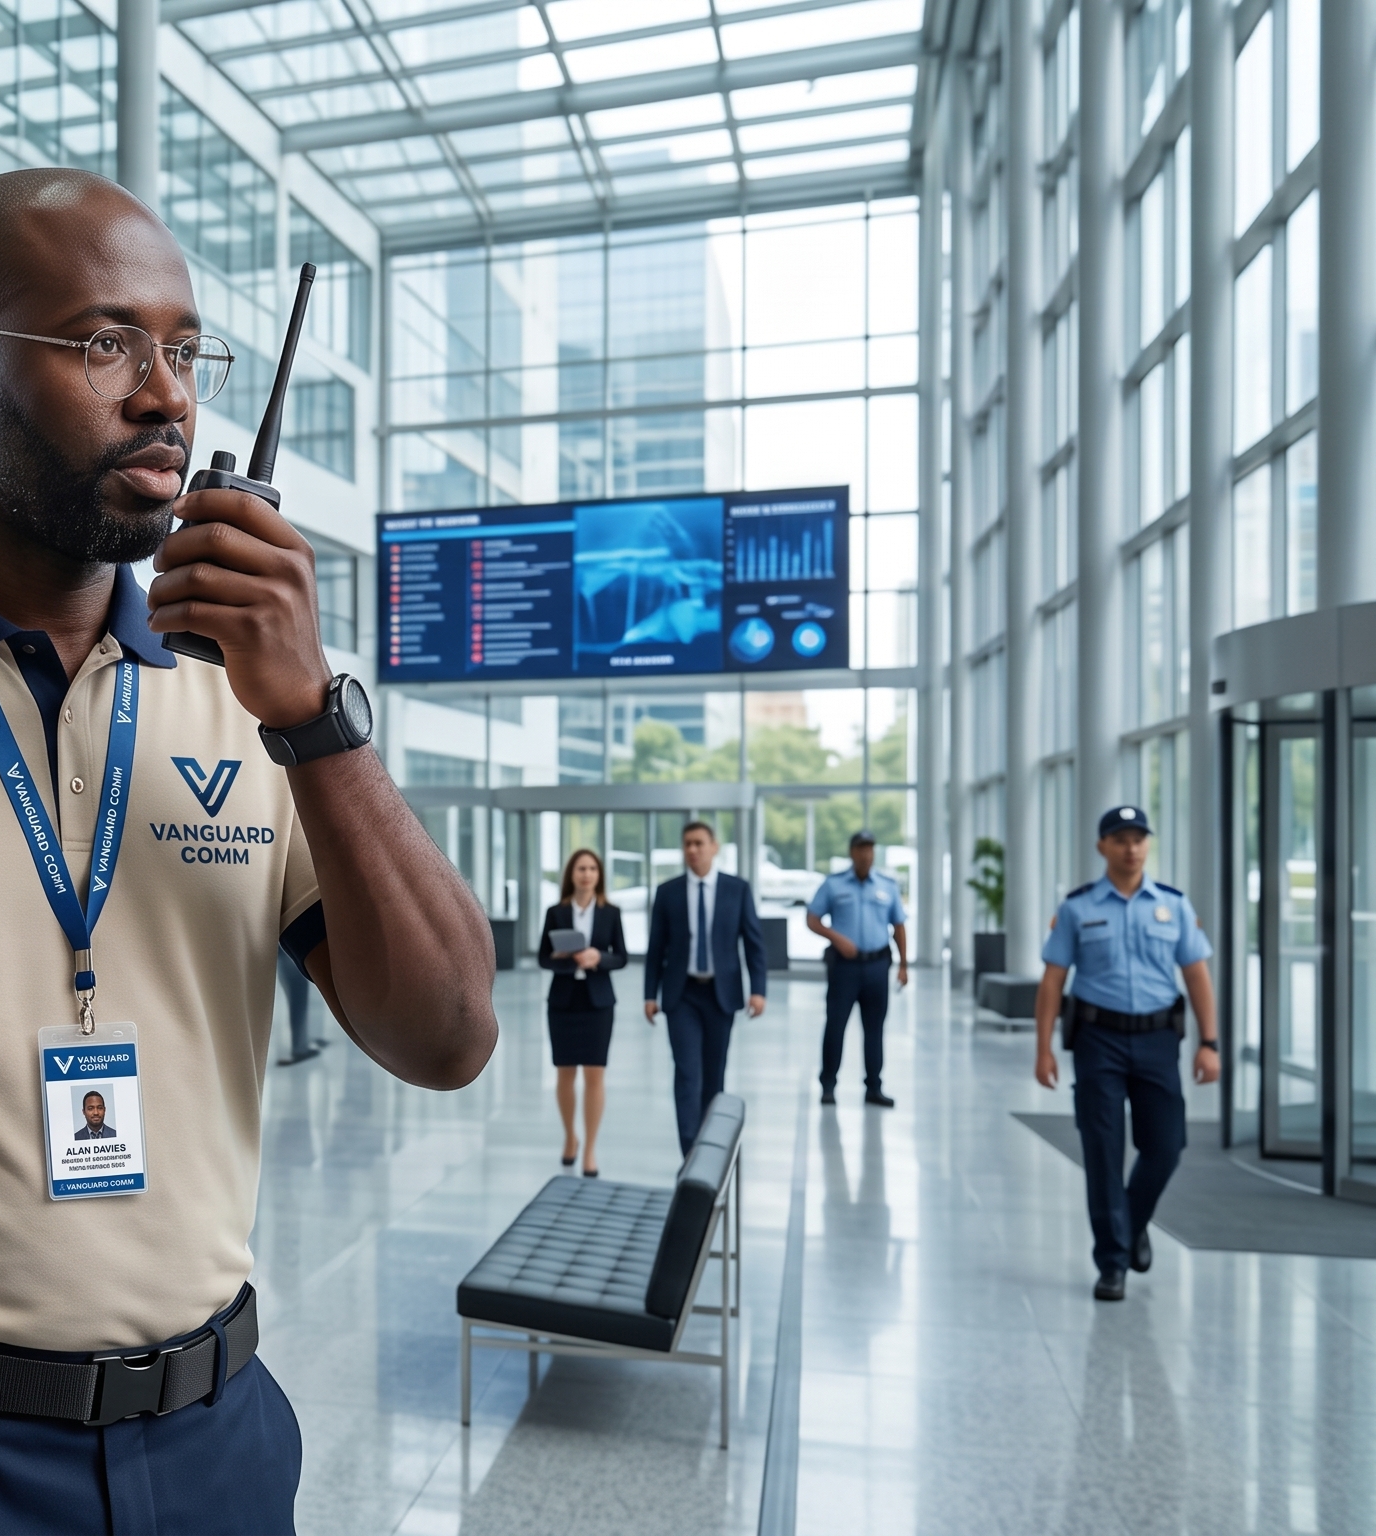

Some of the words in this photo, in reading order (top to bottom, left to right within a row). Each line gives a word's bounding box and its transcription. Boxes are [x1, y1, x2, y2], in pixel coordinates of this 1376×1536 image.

[15, 781, 49, 851] VANGUARD
[98, 808, 117, 872] VANGUARD
[149, 822, 275, 844] VANGUARD
[181, 846, 250, 865] COMM
[77, 1053, 130, 1064] VANGUARD
[66, 1146, 91, 1156] ALAN
[93, 1143, 127, 1154] DAVIES
[109, 1178, 134, 1187] COMM
